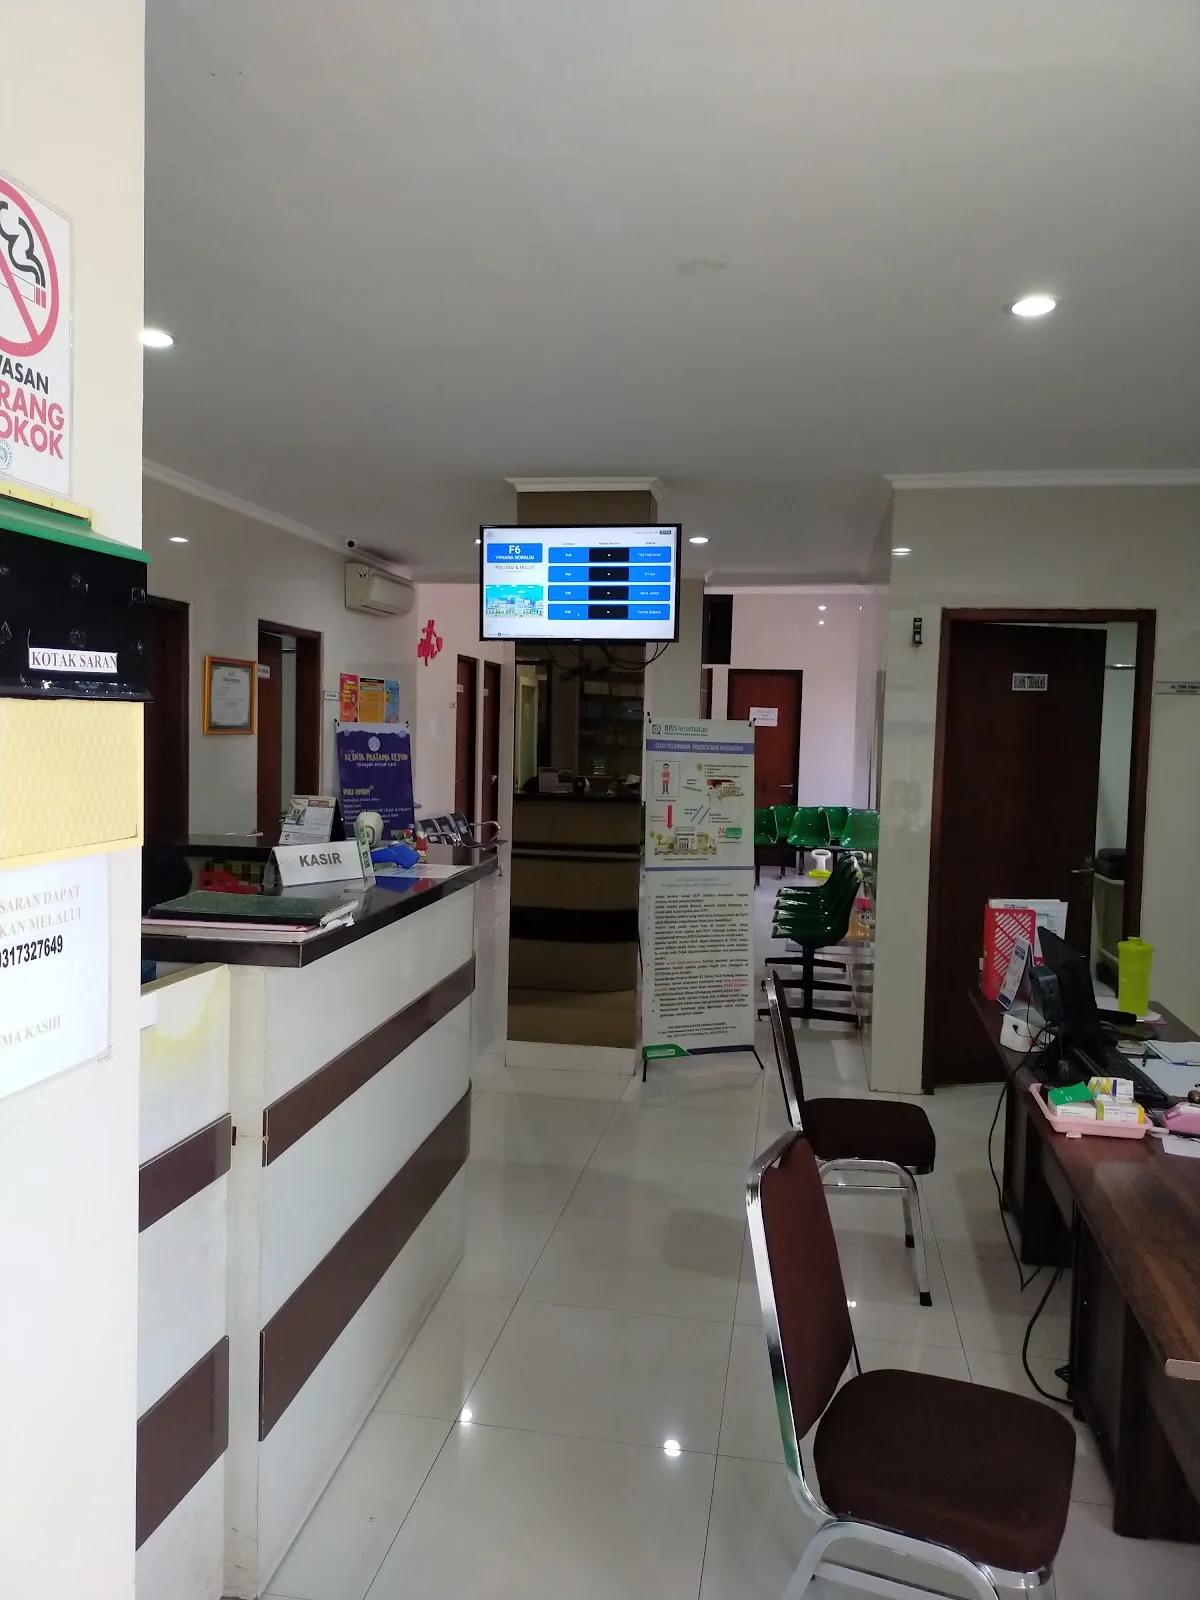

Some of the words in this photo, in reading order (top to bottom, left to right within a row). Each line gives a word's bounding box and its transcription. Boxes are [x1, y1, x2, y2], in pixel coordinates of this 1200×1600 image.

[0, 354, 49, 395] ASAN
[508, 545, 521, 555] F6
[32, 651, 77, 668] KOTAK
[79, 654, 118, 669] SARAN
[664, 724, 677, 732] BPJS
[298, 852, 342, 868] KASIR
[0, 893, 40, 914] SARAN
[43, 885, 81, 905] DAPAT
[29, 906, 82, 932] MELALUI
[24, 1014, 62, 1040] KASIH
